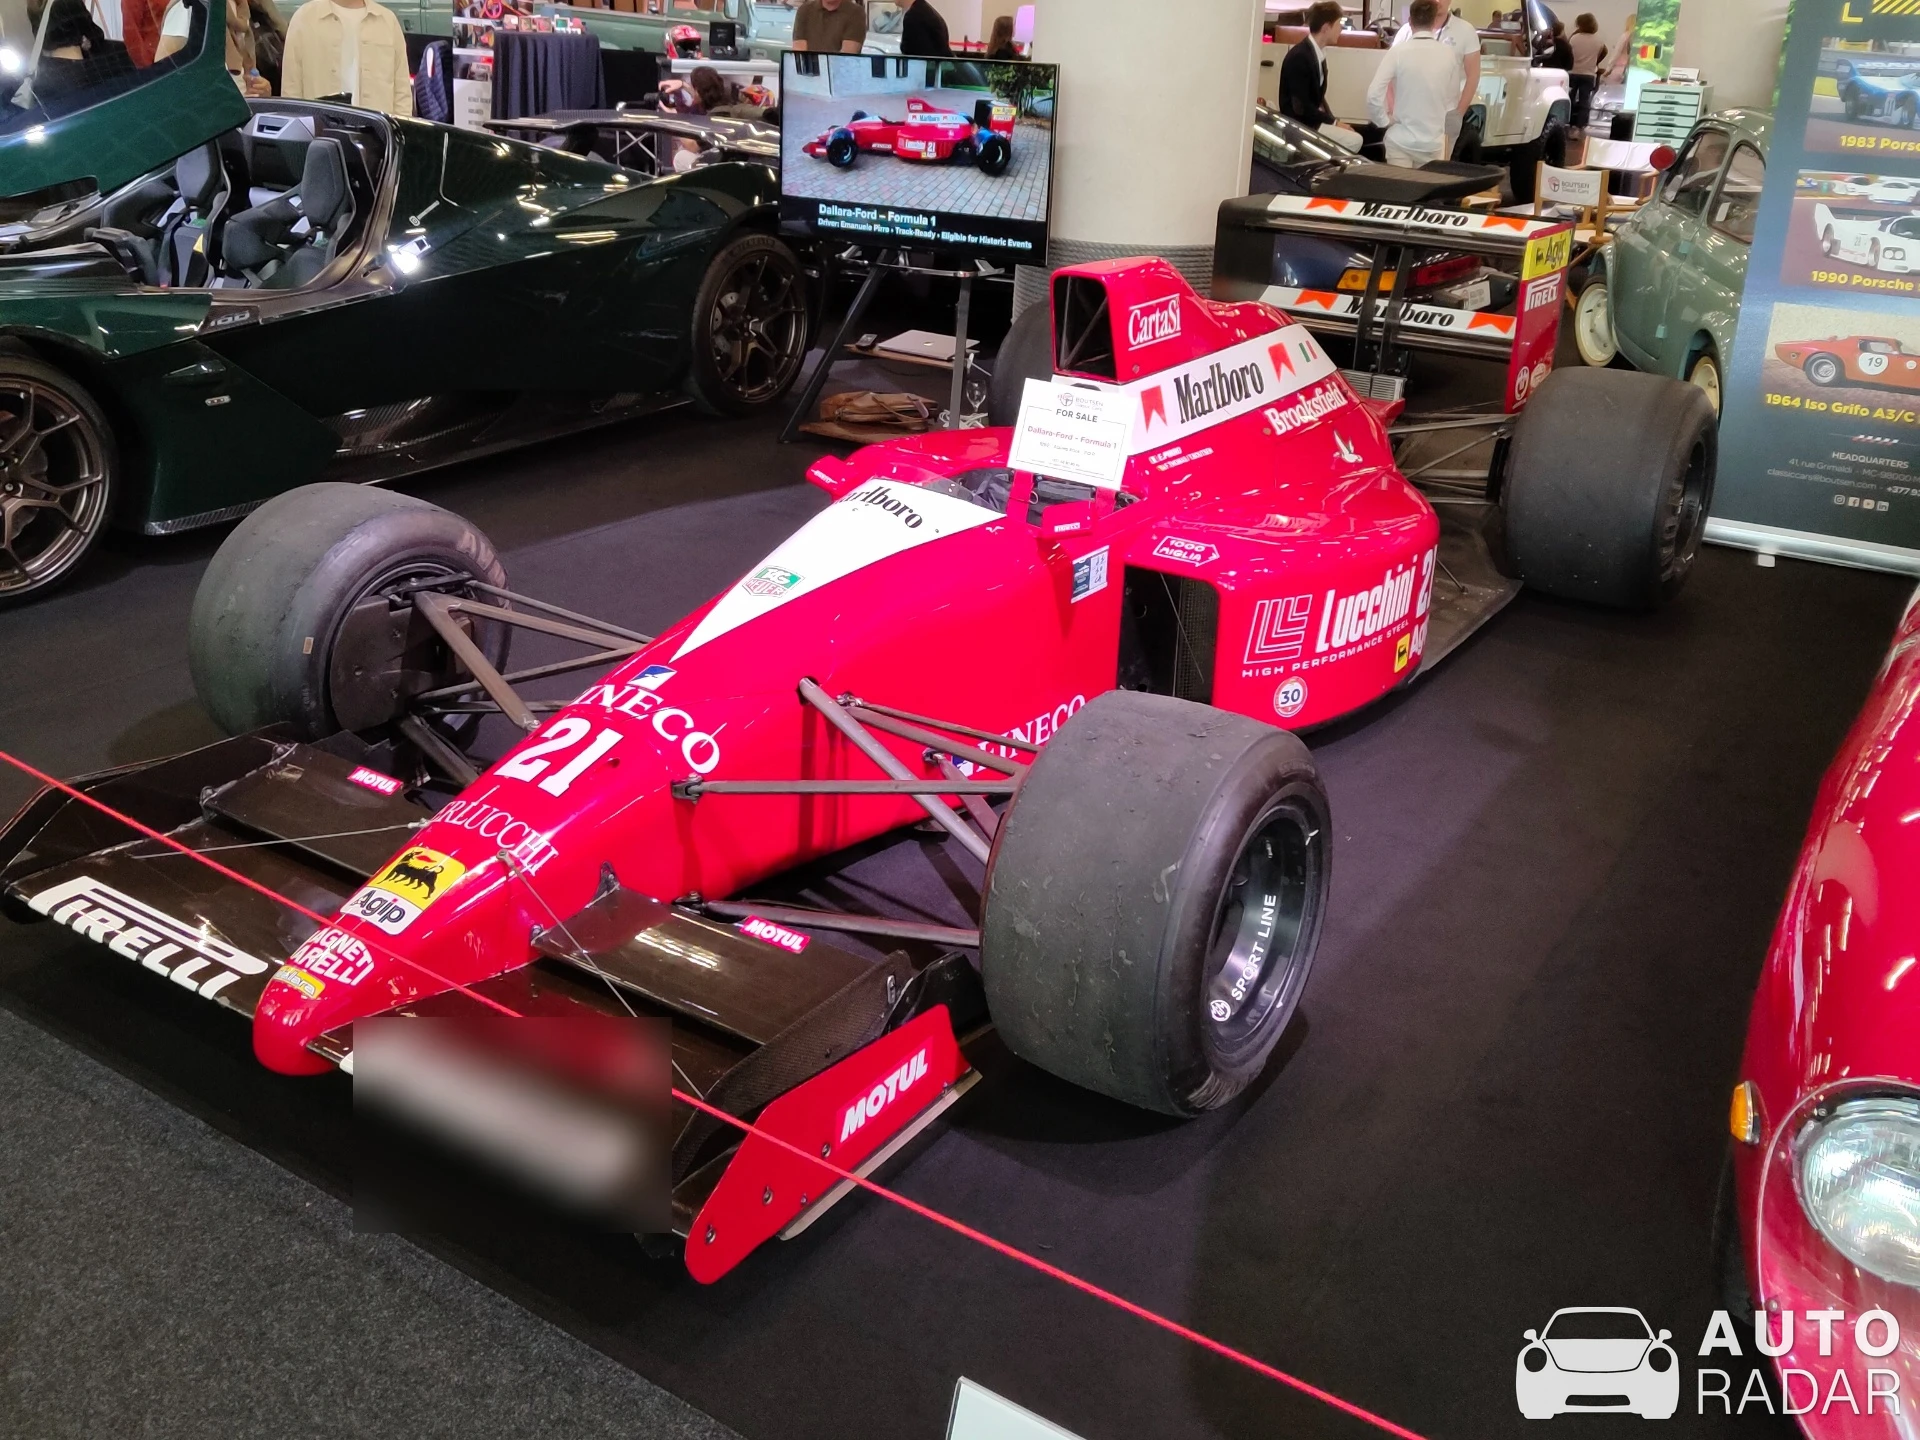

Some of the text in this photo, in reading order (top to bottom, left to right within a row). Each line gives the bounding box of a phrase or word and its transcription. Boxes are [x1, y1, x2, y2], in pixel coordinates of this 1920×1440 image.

[1840, 135, 1876, 148] 1983
[819, 203, 877, 220] Dallara-Ford
[888, 210, 928, 225] Formula
[930, 215, 936, 226] 1
[1356, 202, 1469, 228] Marlboro
[840, 220, 873, 232] Emanuele
[895, 226, 936, 240] Track-Ready
[941, 231, 967, 242] Eligible
[967, 234, 978, 243] for
[979, 235, 1006, 246] Historic
[1007, 238, 1032, 249] Events
[1811, 270, 1914, 291] 1990 Porsche
[1344, 296, 1455, 327] Mrboro
[1867, 356, 1883, 368] 19
[1173, 362, 1265, 424] Marlboro
[1056, 409, 1098, 423] FOR SALE
[1264, 380, 1349, 436] Brooksfield
[1765, 393, 1915, 423] 1964 Iso Grifo A3/C
[1027, 425, 1074, 441] Dallara-Ford
[1080, 436, 1112, 448] Formula
[1801, 460, 1816, 469] rue
[1816, 462, 1853, 474] Grimaldi
[1832, 451, 1909, 469] HEADQUARTERS
[1767, 467, 1877, 490] classiccars@boutsen.com
[1886, 485, 1910, 495] +377
[838, 486, 923, 529] arlboro
[1159, 547, 1202, 561] MIGLIA
[1169, 540, 1205, 552] 1000
[746, 578, 786, 596] HEUER
[760, 567, 791, 585] TAG
[1315, 554, 1418, 654] Lucchini
[1242, 620, 1410, 678] HIGH PERFORMANCE STEEL
[1280, 688, 1301, 705] 30
[569, 684, 720, 774] INECO
[493, 717, 624, 797] 21
[351, 769, 397, 793] MOTUL
[350, 890, 406, 925] Agip
[28, 876, 268, 1000] PIRELLI
[745, 919, 804, 950] MOTUL
[1231, 894, 1277, 1001] SPORT LINE
[310, 927, 374, 973] AGNETI
[290, 944, 375, 986] ARELLI
[840, 1048, 929, 1143] MOTUL
